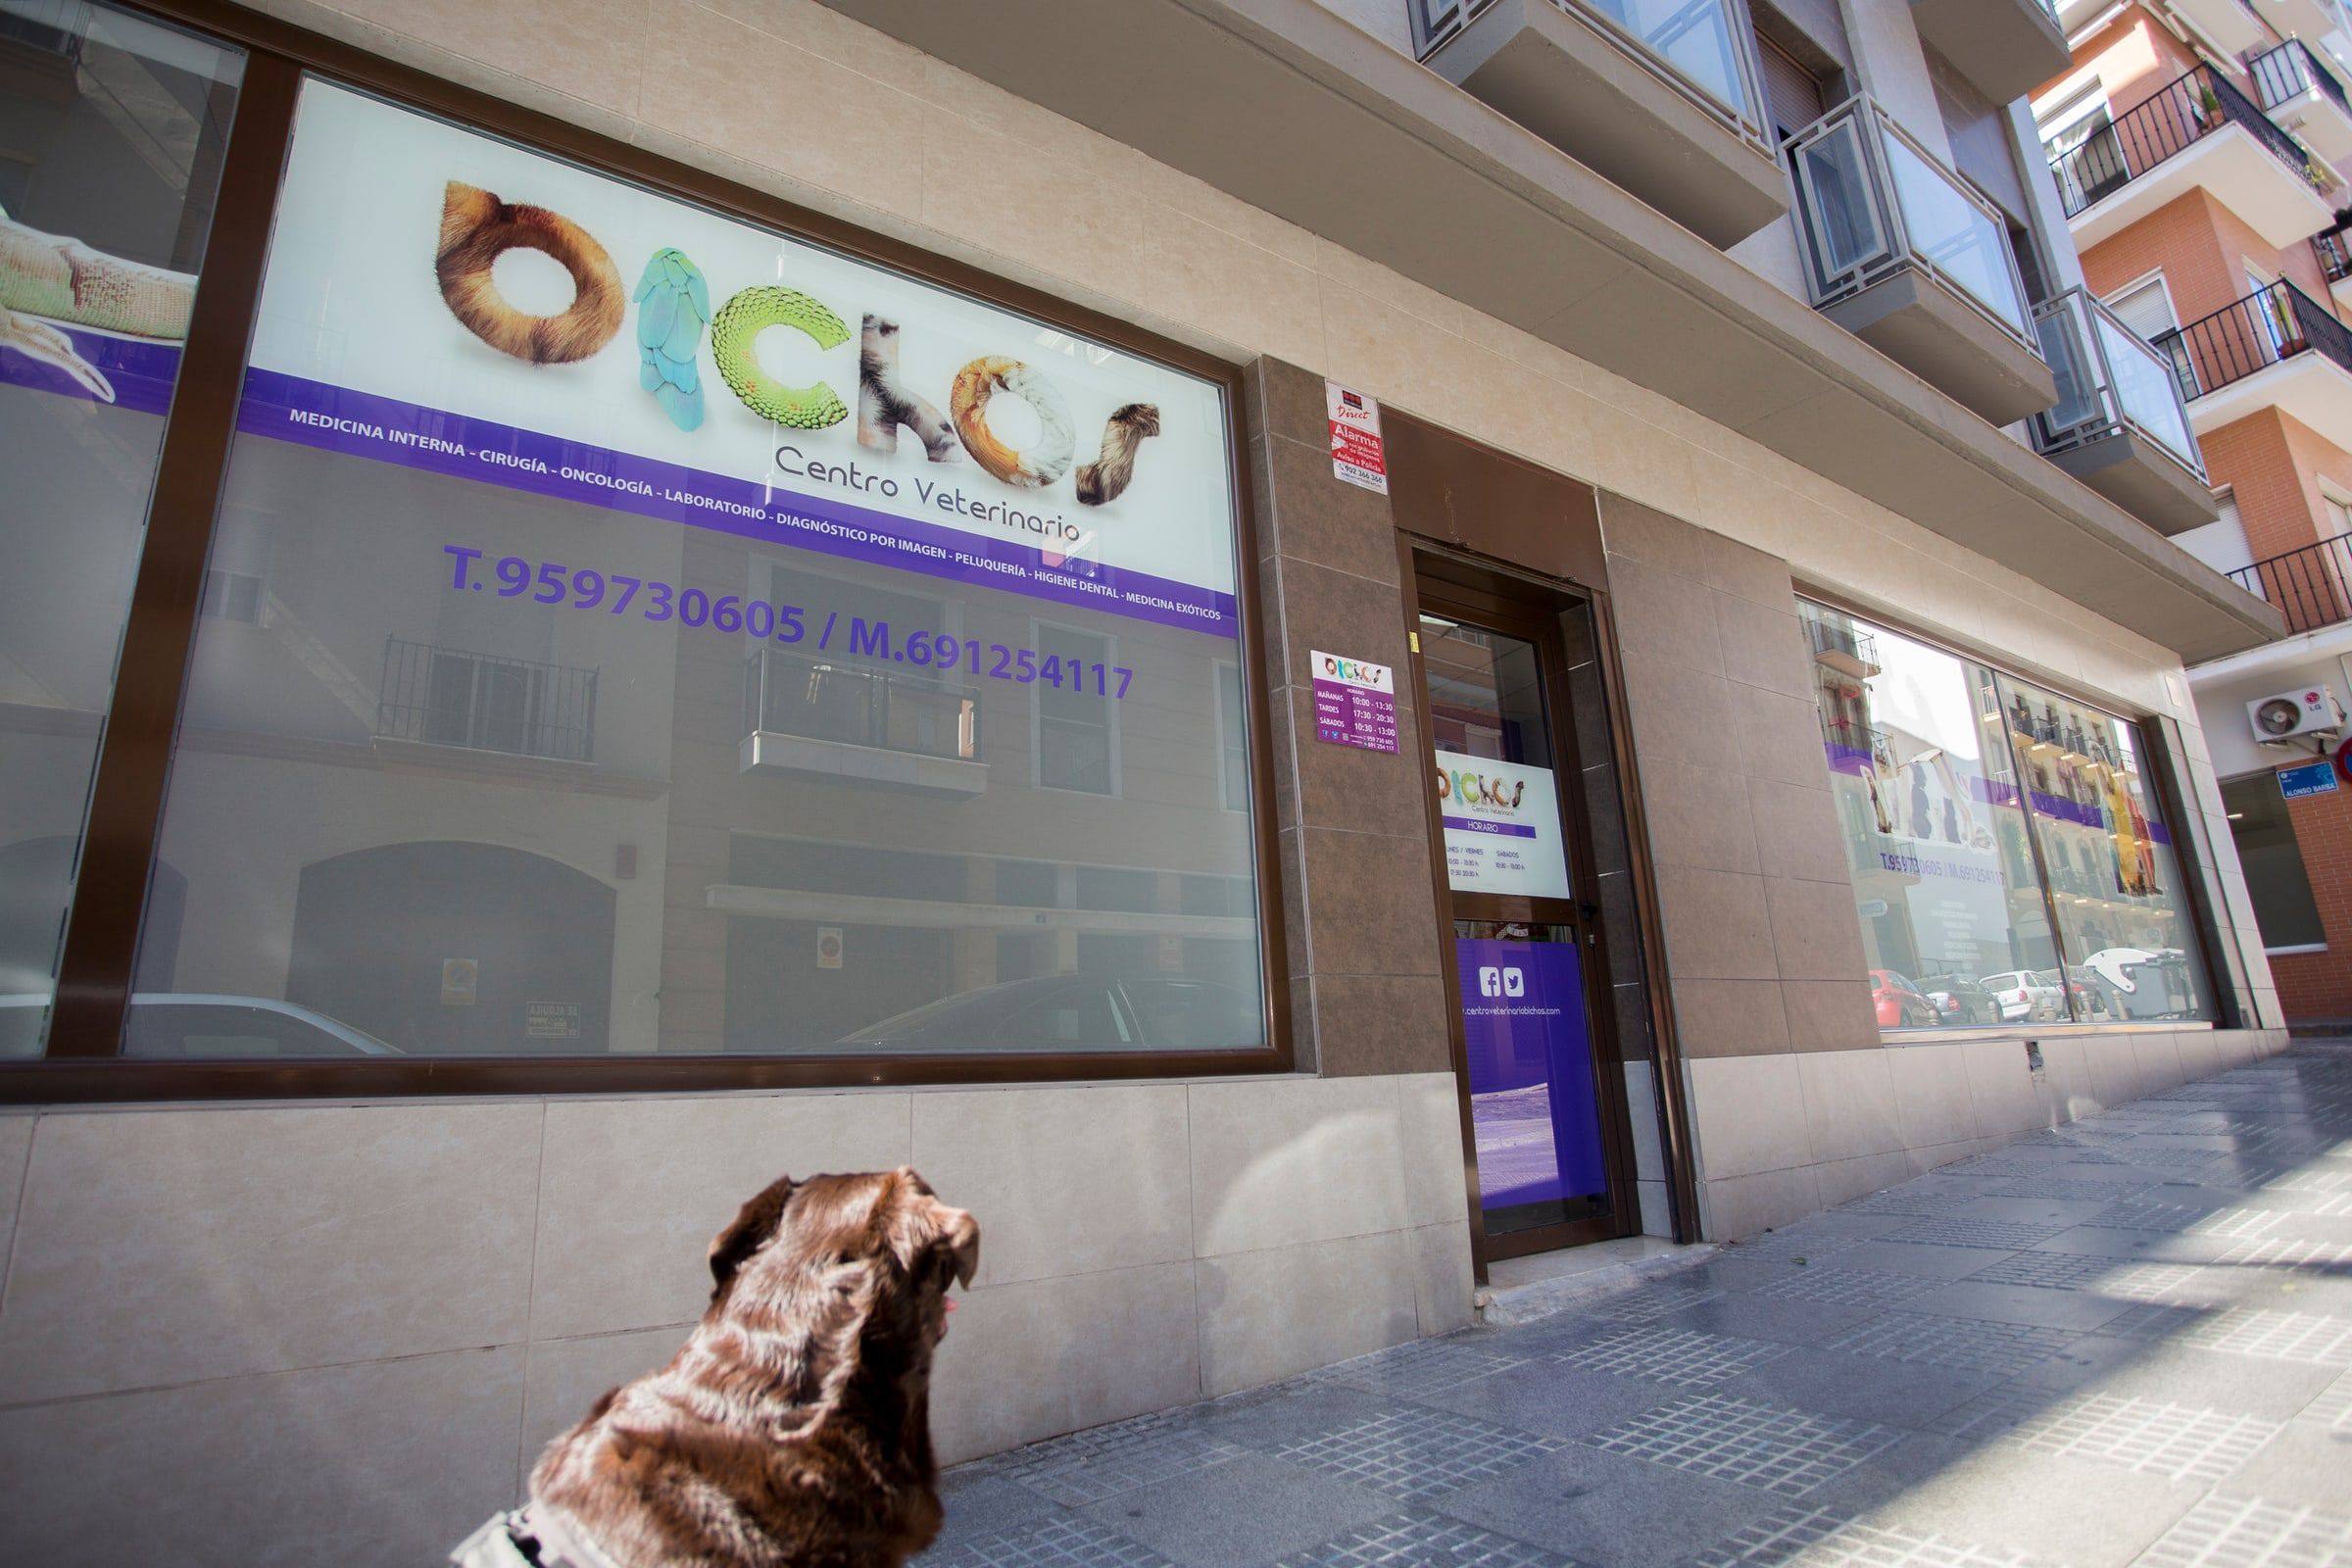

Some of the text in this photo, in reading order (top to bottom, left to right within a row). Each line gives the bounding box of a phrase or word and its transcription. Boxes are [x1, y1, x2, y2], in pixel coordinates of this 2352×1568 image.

[1337, 404, 1371, 419] Direct
[1335, 424, 1378, 449] Alarma
[1337, 451, 1354, 463] Aviso
[775, 446, 1079, 541] Centro Veterinario
[289, 409, 384, 440] MEDICINA
[389, 429, 466, 457] INTERNA
[479, 449, 547, 474] CIRUGÍA
[560, 466, 654, 497] ONCOLOGÍA
[664, 489, 766, 520] LABORATORIO
[777, 513, 867, 541] DIAGNÓSTICO
[870, 533, 896, 548] POR
[898, 539, 946, 560] IMAGEN
[955, 553, 1026, 578] PELUQUERÍA
[1034, 570, 1077, 589] HIGIENE
[1079, 581, 1119, 599] DENTAL
[1126, 592, 1174, 611] MEDICINA
[1176, 602, 1221, 620] EXÓTICOS
[849, 616, 1133, 699] M.691254117
[1317, 690, 1344, 702] MAÑANAS
[1352, 697, 1370, 707] 10:00
[1376, 701, 1393, 711] 13:30
[1318, 704, 1339, 713] TARDES
[1353, 710, 1371, 719] 17:30
[1376, 713, 1394, 723] 20:30
[1319, 715, 1345, 727] SÁBADOS
[1354, 722, 1372, 733] 10:30
[1378, 726, 1396, 737] 13:00
[2285, 787, 2312, 797] ALONSO
[1467, 820, 1498, 833] HORARIO
[1462, 1006, 1561, 1016] .centroveterinariobichos.com
